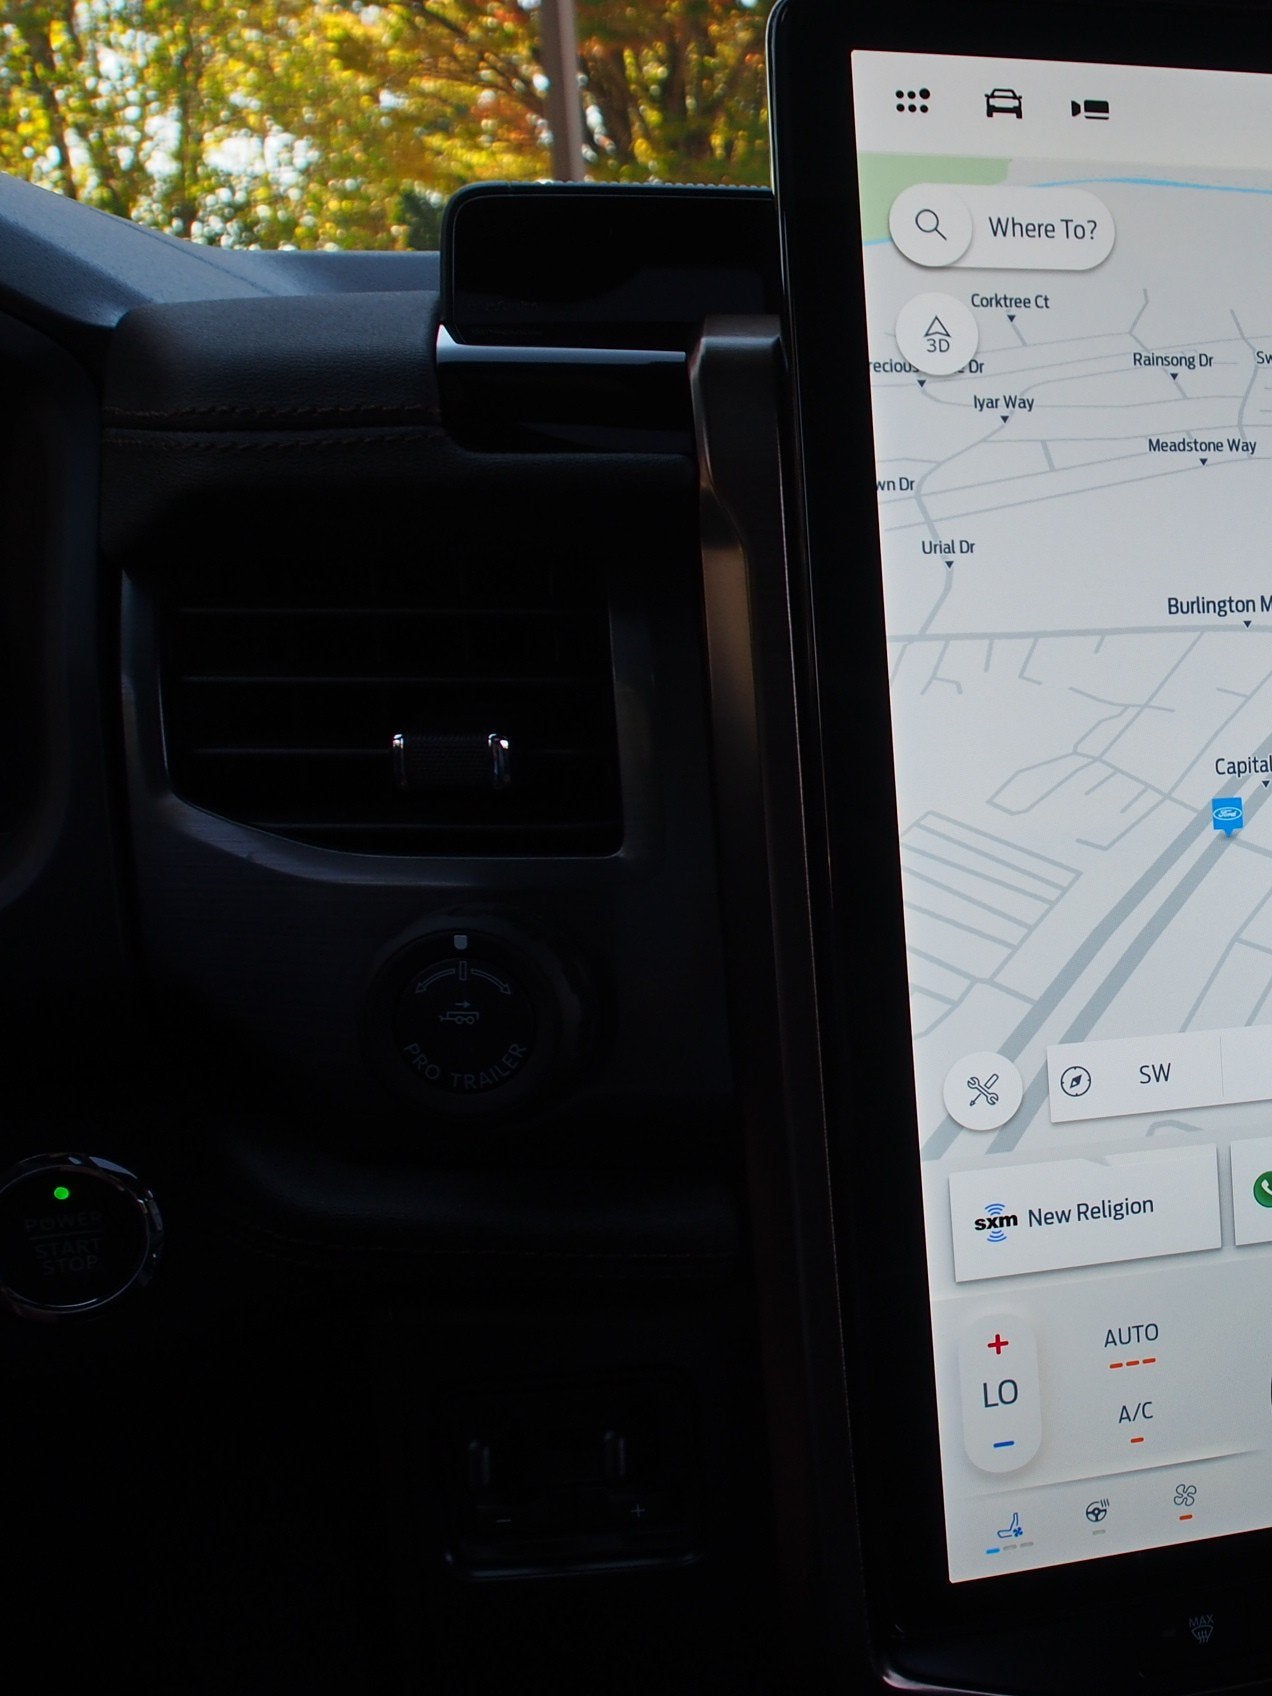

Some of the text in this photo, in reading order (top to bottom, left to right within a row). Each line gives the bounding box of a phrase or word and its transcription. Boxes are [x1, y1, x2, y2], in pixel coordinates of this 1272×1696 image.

[988, 216, 1098, 241] Where To?
[971, 293, 1050, 309] Corktree Ct
[926, 338, 951, 354] 3D
[968, 359, 985, 374] Dr
[1133, 352, 1214, 370] Rainsong Dr
[973, 395, 1035, 412] Iyar Way
[1148, 438, 1257, 455] Meadstone Way
[899, 477, 915, 491] Dr
[921, 540, 976, 555] Urial Dr
[1167, 596, 1256, 618] Burlington
[404, 1042, 528, 1090] PRO TRAILER
[1139, 1062, 1172, 1085] SW
[1028, 1197, 1155, 1228] New Religion
[974, 1213, 1018, 1231] sxm
[1104, 1322, 1159, 1348] AUTO
[982, 1378, 1019, 1409] LO
[1118, 1401, 1154, 1424] A/C
[1188, 1613, 1215, 1628] MAX
